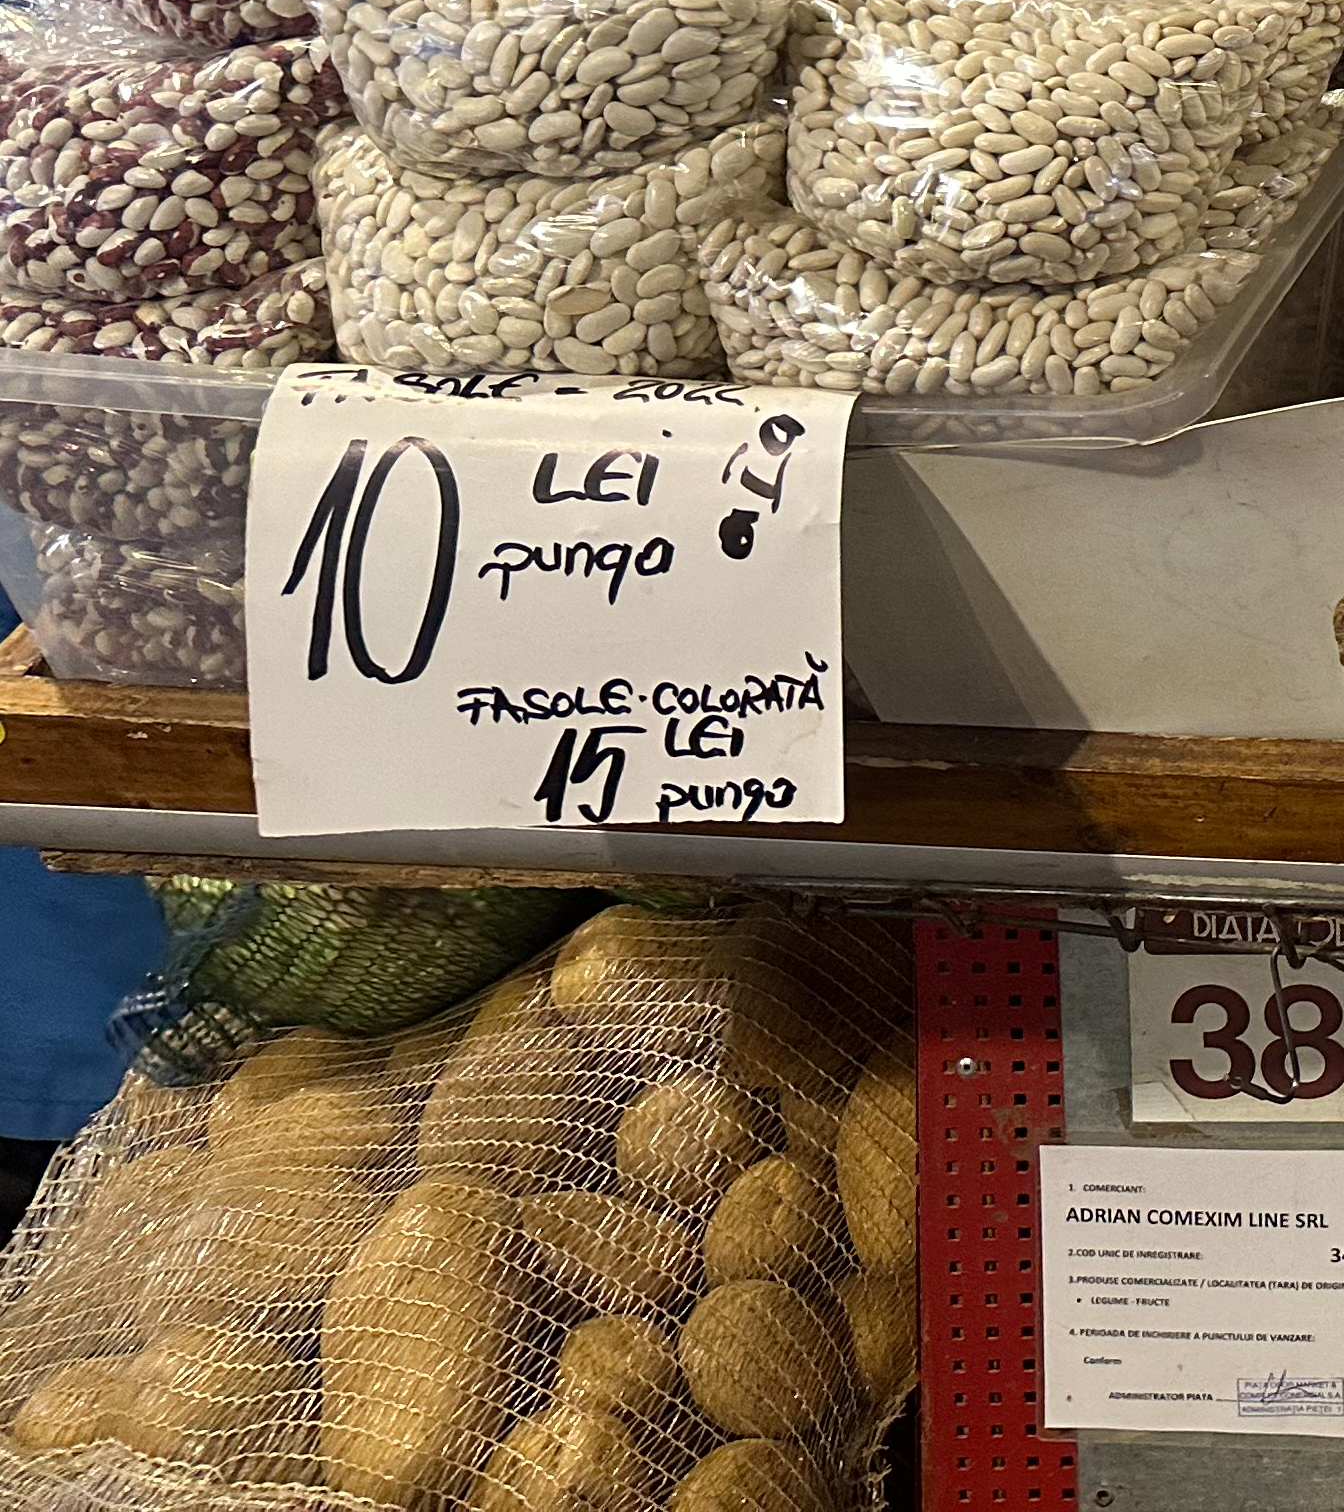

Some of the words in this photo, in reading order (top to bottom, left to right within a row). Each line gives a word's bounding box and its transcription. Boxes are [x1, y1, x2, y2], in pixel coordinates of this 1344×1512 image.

[282, 436, 461, 685] 10
[534, 725, 647, 823] 15
[1066, 1207, 1141, 1224] ADRIAN
[1147, 1209, 1242, 1228] COMEXIM
[1249, 1212, 1290, 1229] LINE
[1295, 1213, 1329, 1229] SRL
[1098, 1249, 1121, 1258] UNIC
[1207, 1279, 1265, 1289] LOCALITATEA
